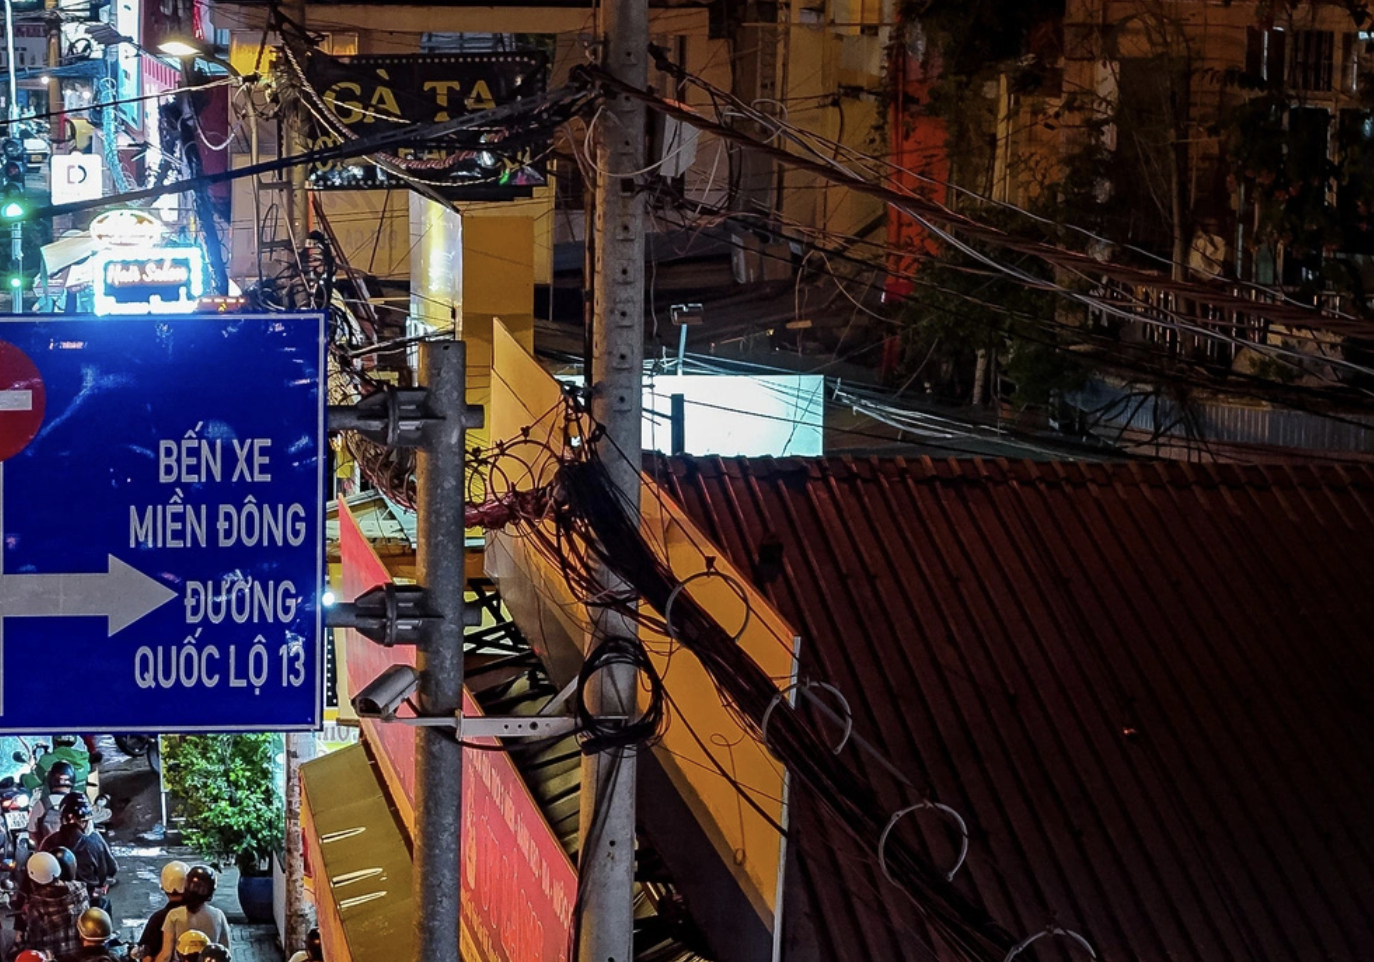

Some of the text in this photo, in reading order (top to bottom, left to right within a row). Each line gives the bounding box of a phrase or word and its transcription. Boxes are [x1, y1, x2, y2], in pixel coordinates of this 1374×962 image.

[323, 68, 498, 125] GÀ TA
[159, 421, 272, 483] BẾN XE
[129, 488, 306, 548] MIỀN ĐÔNG
[184, 569, 297, 625] ĐƯỜNG
[134, 627, 306, 695] QUỐC LỘ 13
